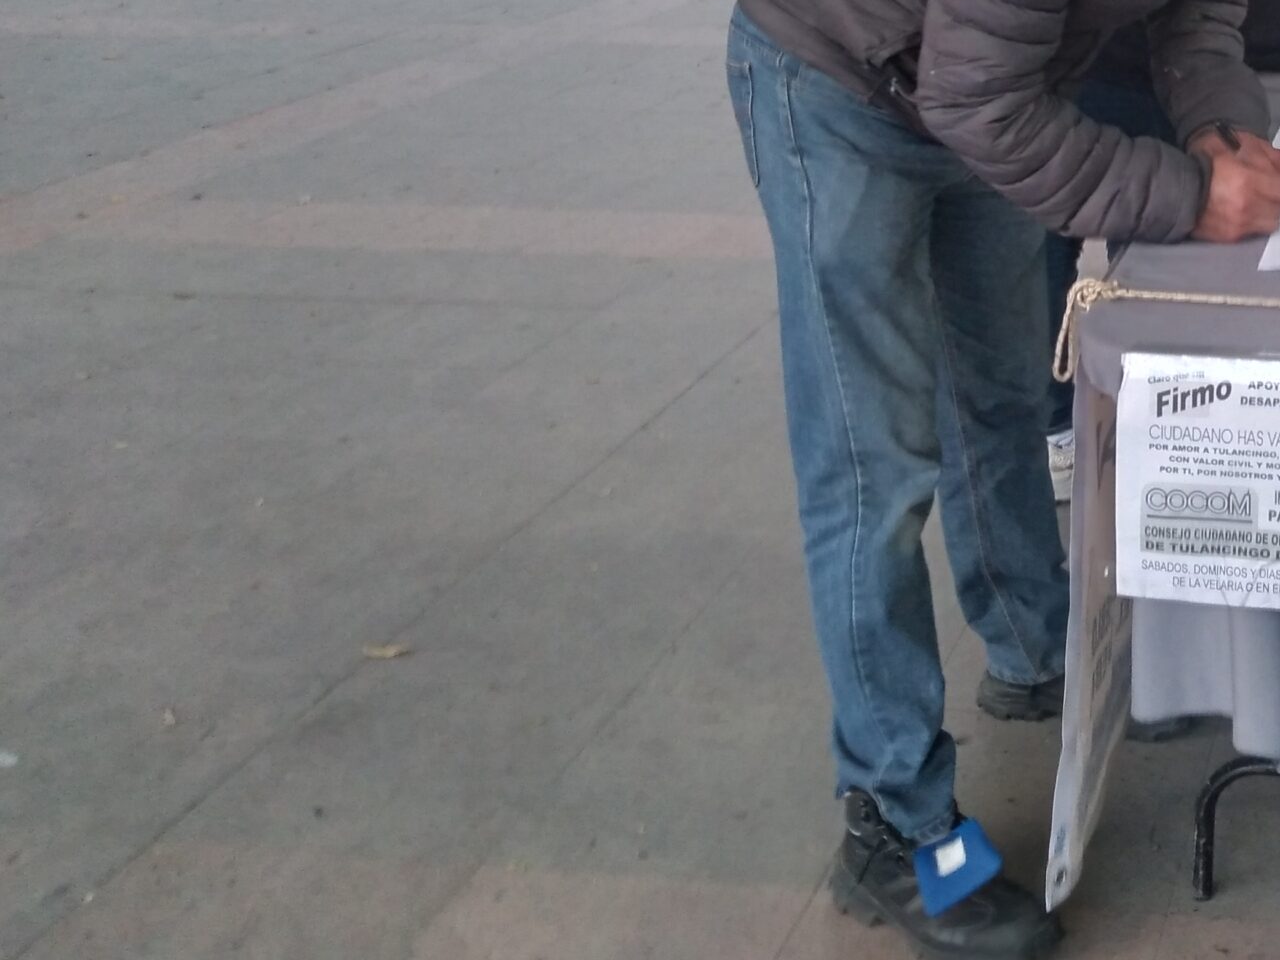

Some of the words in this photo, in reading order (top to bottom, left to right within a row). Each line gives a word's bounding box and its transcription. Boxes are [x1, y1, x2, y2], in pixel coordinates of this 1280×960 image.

[1148, 375, 1171, 384] Claro
[1157, 380, 1232, 418] Firmo
[1149, 424, 1233, 444] CIUDADANO
[1237, 429, 1264, 447] HAS
[1172, 445, 1200, 453] AMOR
[1213, 447, 1279, 459] TULANCINGO,
[1169, 455, 1189, 463] CON
[1193, 457, 1224, 466] VALOR
[1228, 459, 1253, 468] CIVIL
[1257, 461, 1263, 469] Y
[1160, 465, 1179, 474] POR
[1197, 468, 1217, 476] POR
[1220, 470, 1274, 480] NOSOTROS
[1146, 487, 1251, 516] COCOM
[1144, 526, 1191, 540] CONSEJO
[1194, 528, 1252, 543] CIUDADANO
[1255, 532, 1269, 545] DE
[1145, 540, 1165, 551] DE
[1170, 542, 1271, 559] TULANCINGO
[1193, 564, 1248, 578] DOMINGOS
[1250, 568, 1257, 579] Y
[1172, 576, 1186, 587] DE
[1188, 577, 1201, 588] LA
[1203, 579, 1243, 592] VELARIA
[1245, 582, 1253, 592] O
[1256, 582, 1269, 593] EN
